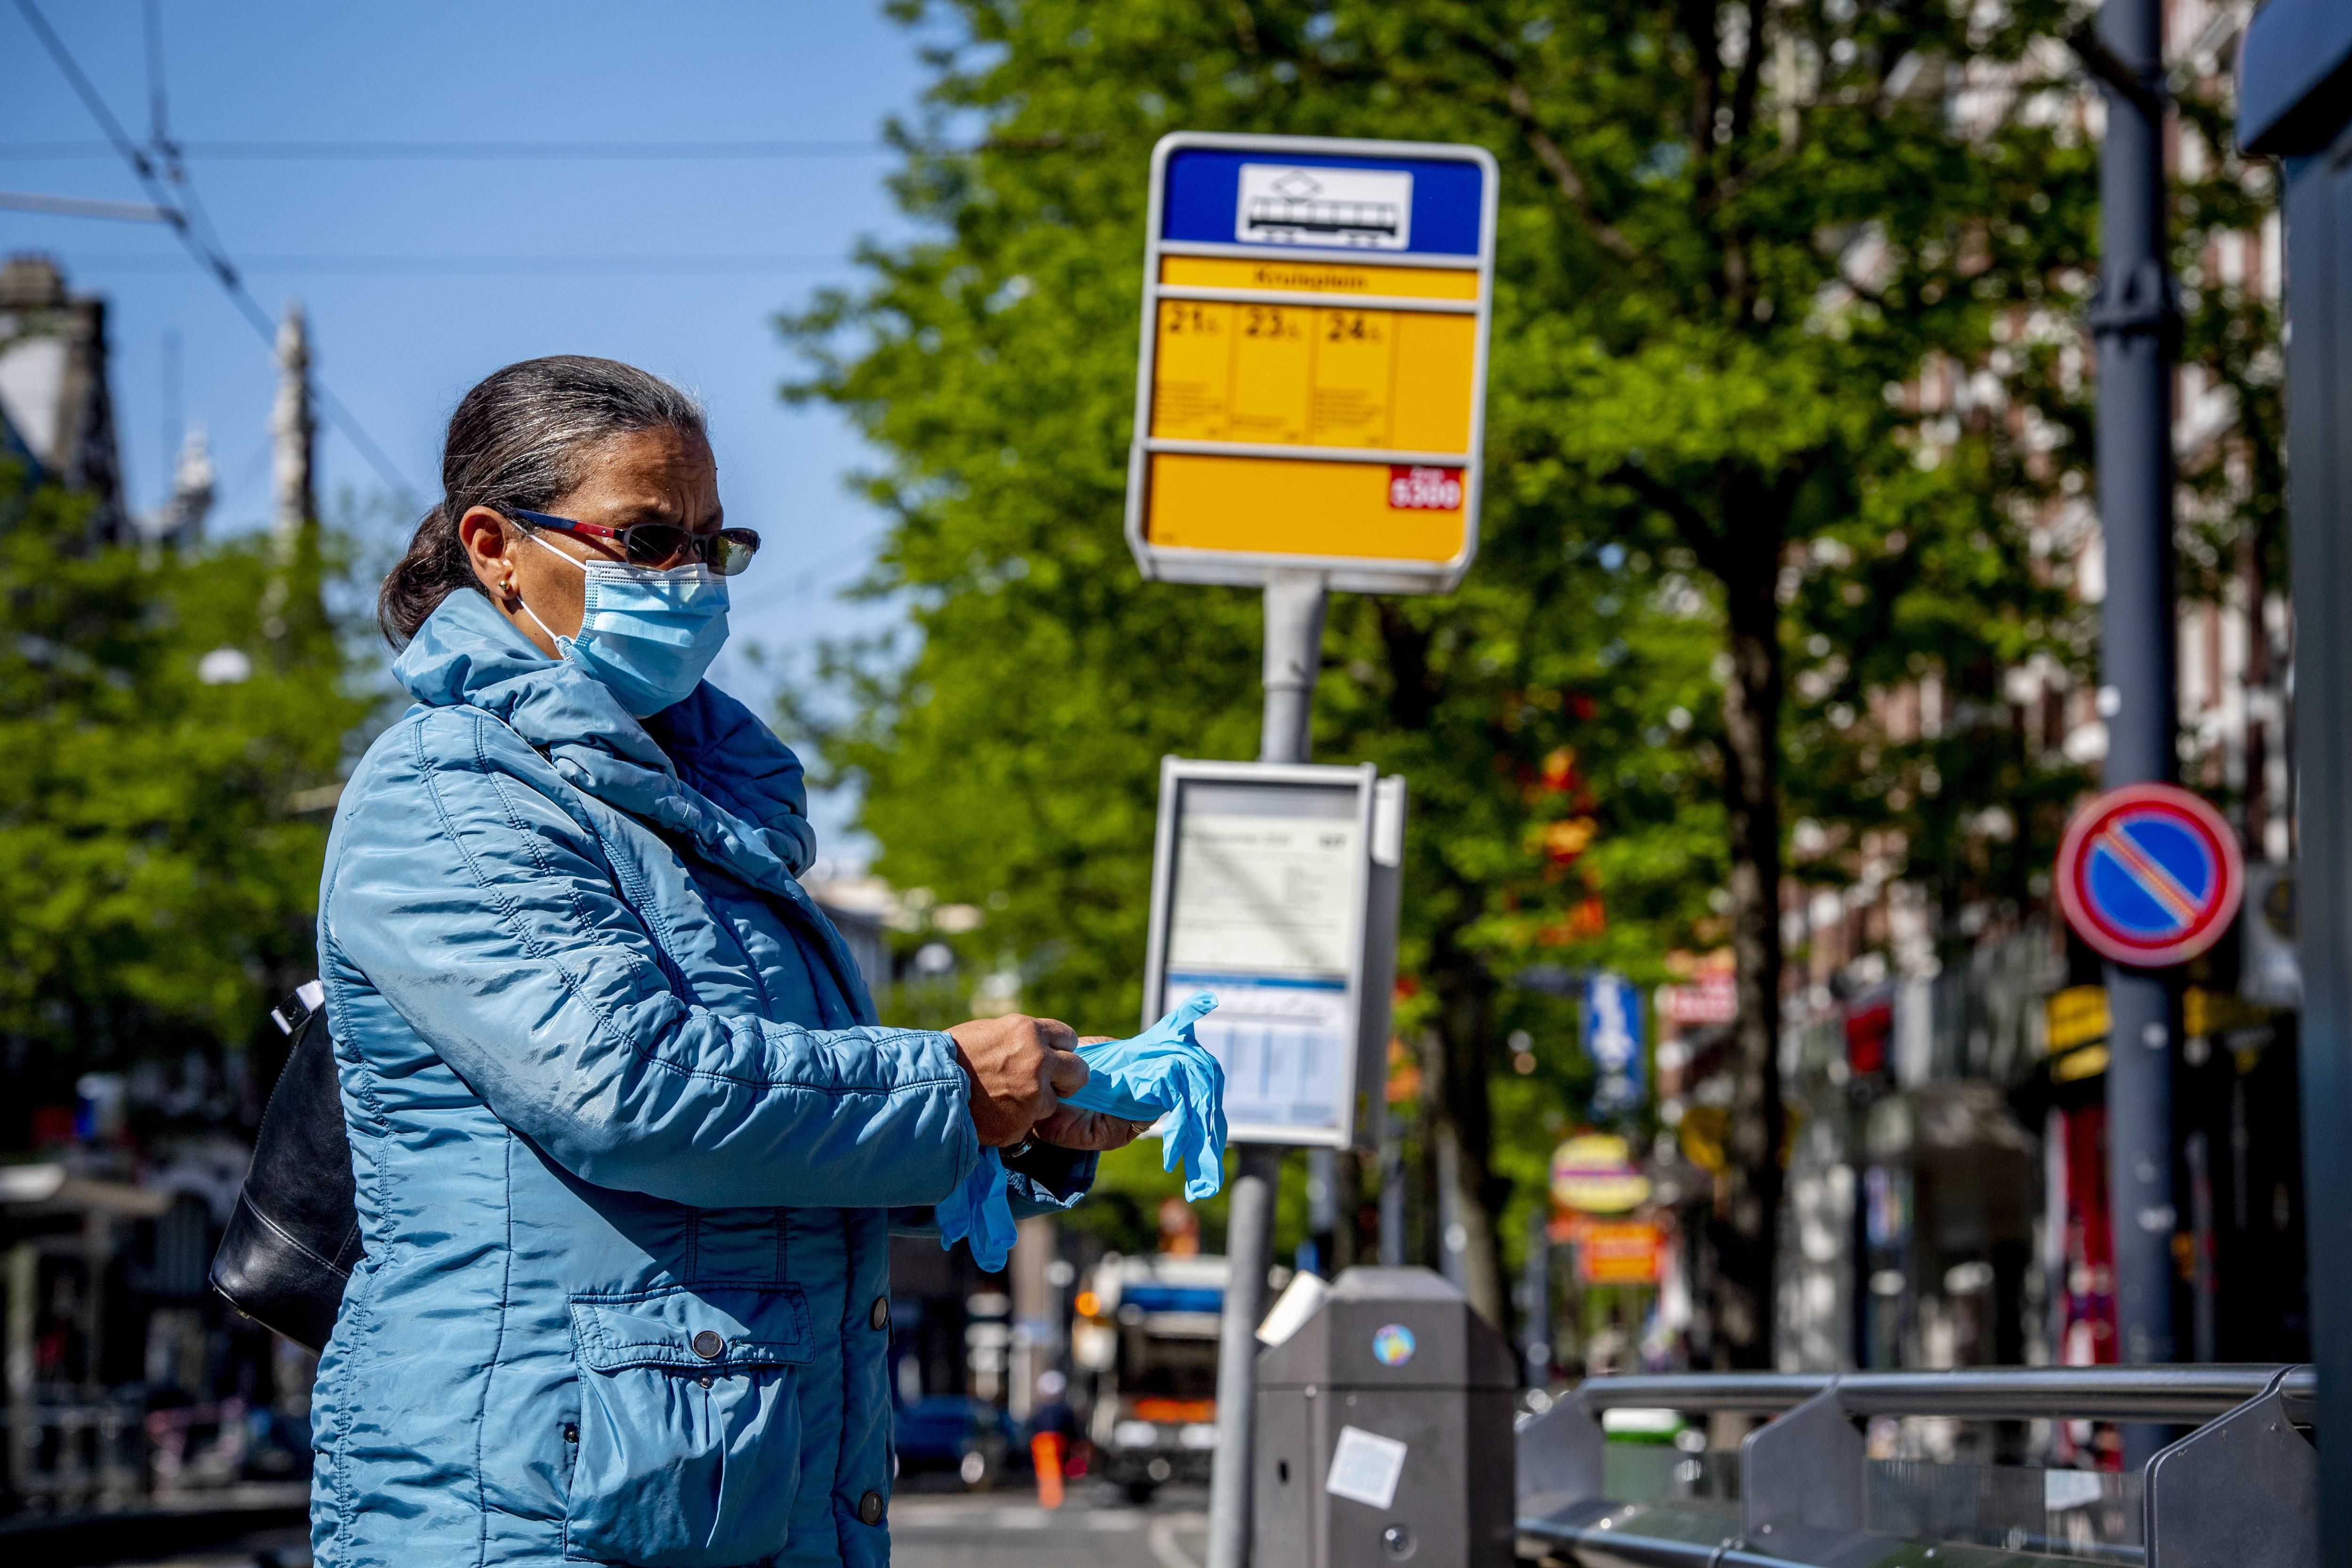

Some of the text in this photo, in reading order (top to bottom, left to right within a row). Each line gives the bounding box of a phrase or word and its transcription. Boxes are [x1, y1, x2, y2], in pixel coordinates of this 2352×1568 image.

[1254, 267, 1368, 291] Kruisplein
[1167, 306, 1203, 335] 21
[1245, 309, 1285, 340] 23
[1326, 313, 1367, 344] 24
[1392, 479, 1461, 508] 5300
